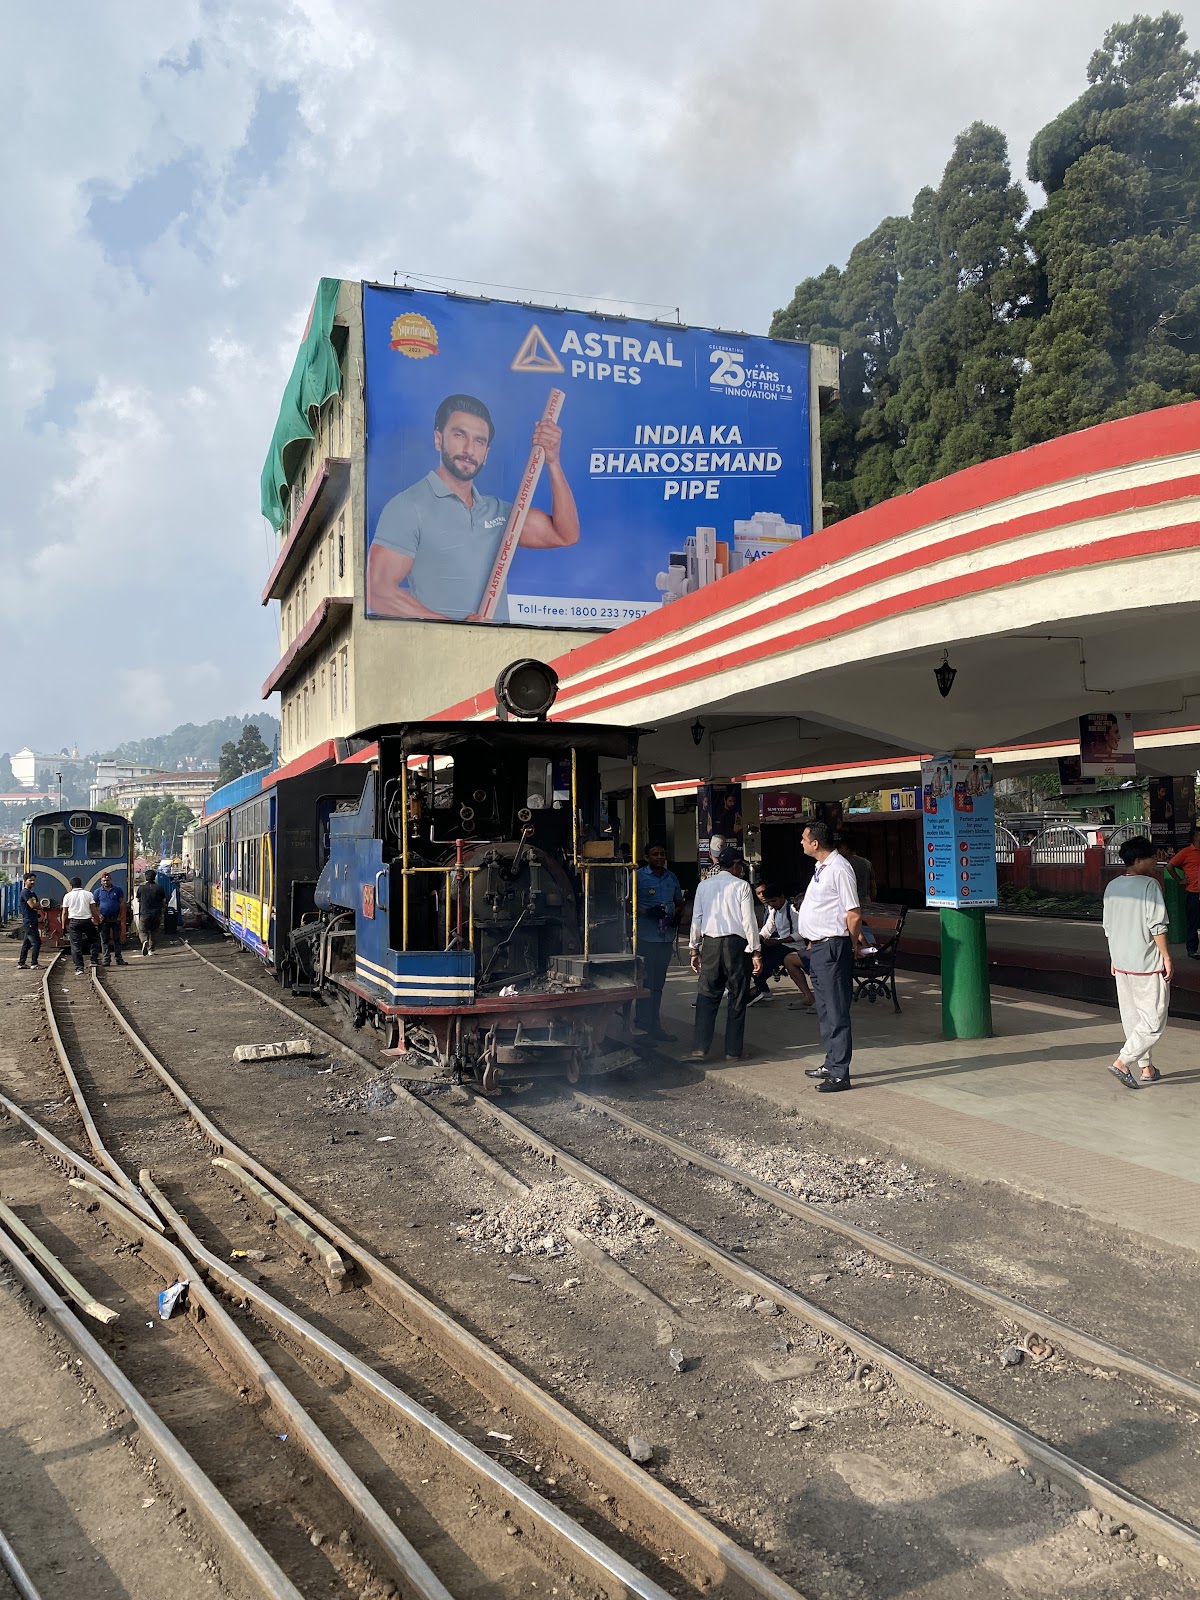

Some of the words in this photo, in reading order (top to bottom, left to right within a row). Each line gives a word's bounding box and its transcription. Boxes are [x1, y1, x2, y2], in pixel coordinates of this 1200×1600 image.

[397, 322, 431, 338] Superbrands
[560, 329, 683, 367] ASTRAL
[708, 344, 744, 353] CELEBRATING
[571, 359, 642, 385] PIPES
[709, 350, 745, 387] 25
[745, 368, 779, 382] YEARS
[725, 387, 778, 400] INNOVATION
[745, 380, 757, 388] OF
[759, 382, 785, 392] TRUST
[786, 385, 793, 393] &
[547, 391, 561, 418] ASTRAL
[634, 425, 705, 445] INDIA
[709, 425, 743, 445] KA
[589, 452, 783, 473] BHAROSEMAND
[520, 475, 534, 503] ASTRAL
[663, 480, 721, 500] PIPE
[491, 562, 505, 590] ASTRAL
[518, 603, 568, 616] Toll-free:
[571, 606, 597, 617] 1800
[600, 608, 619, 618] 233
[622, 609, 647, 619] 7957
[901, 793, 914, 808] LIC
